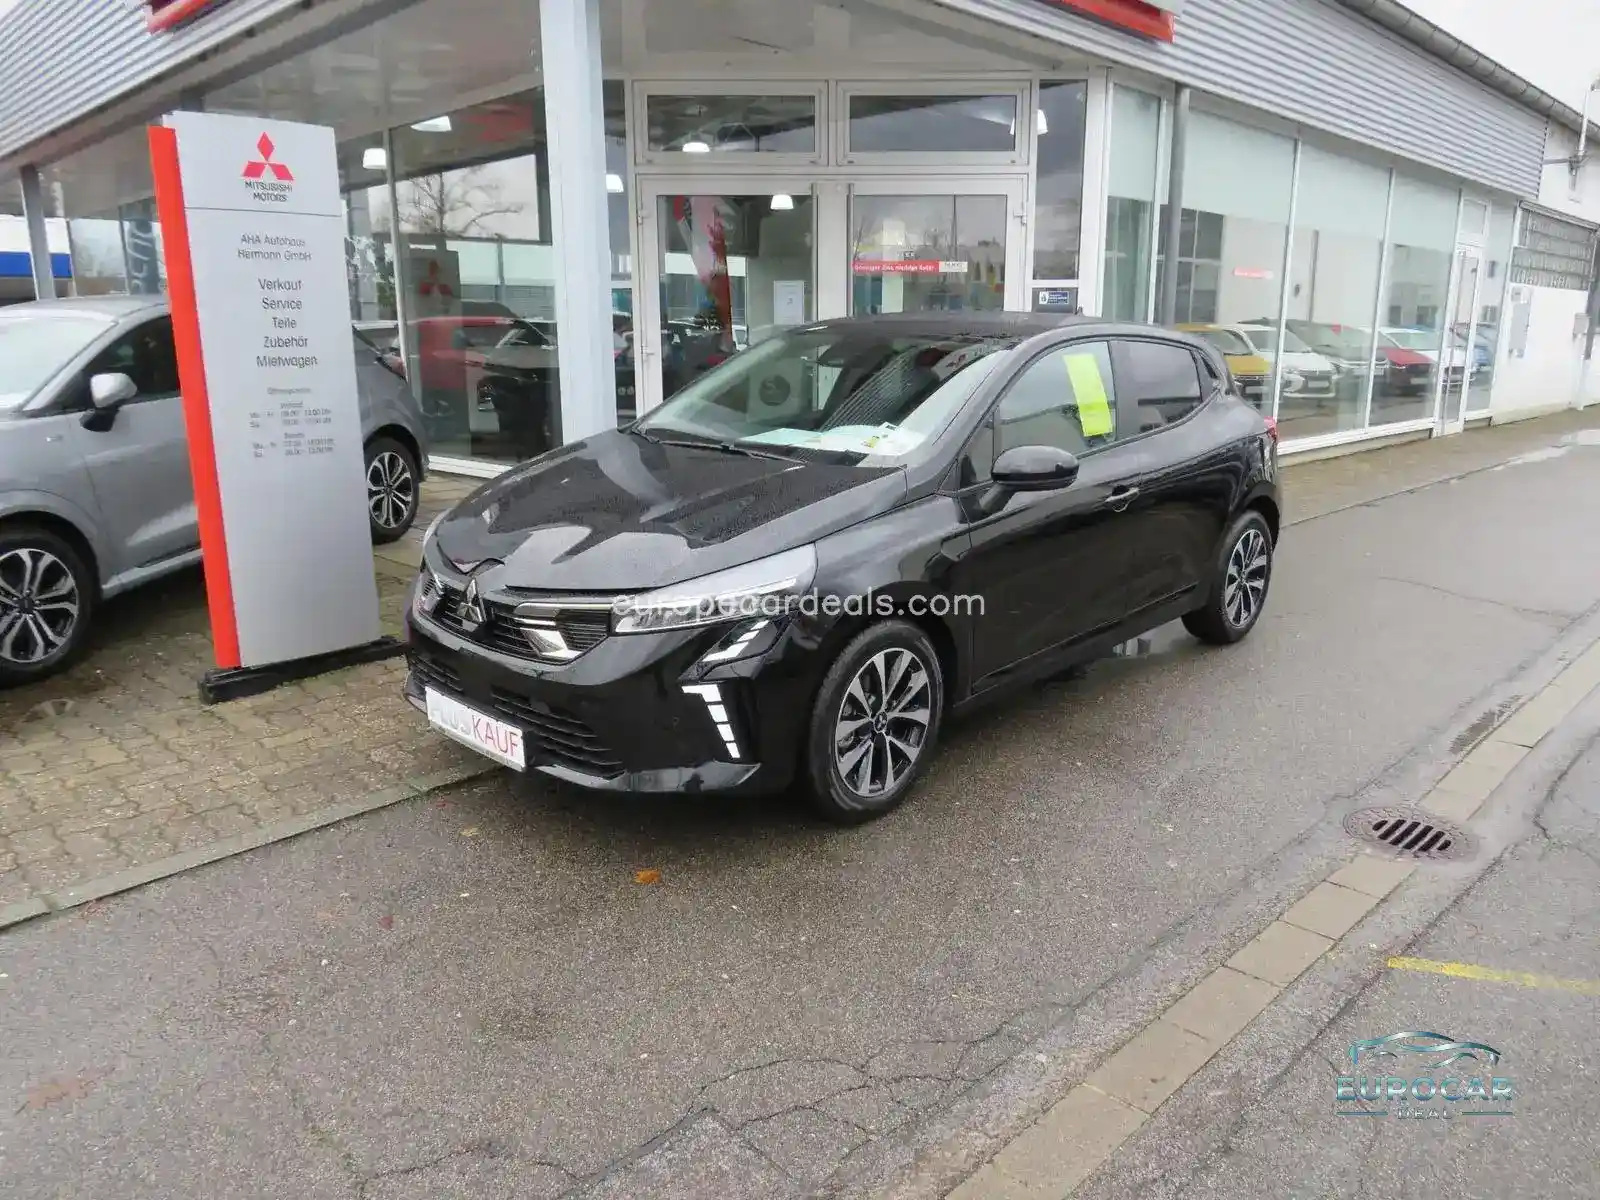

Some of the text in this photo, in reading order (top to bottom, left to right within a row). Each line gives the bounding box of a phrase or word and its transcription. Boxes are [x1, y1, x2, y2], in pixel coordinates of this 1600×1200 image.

[245, 181, 293, 192] MITSUBISHI
[253, 192, 288, 202] MOTORS
[241, 234, 306, 247] AHA Autohaus
[284, 250, 313, 262] GmbH
[258, 278, 303, 291] Verkauf
[261, 297, 303, 310] Service
[272, 316, 297, 329] Teile
[263, 335, 308, 348] Zubehör
[256, 355, 318, 368] Mietwagen
